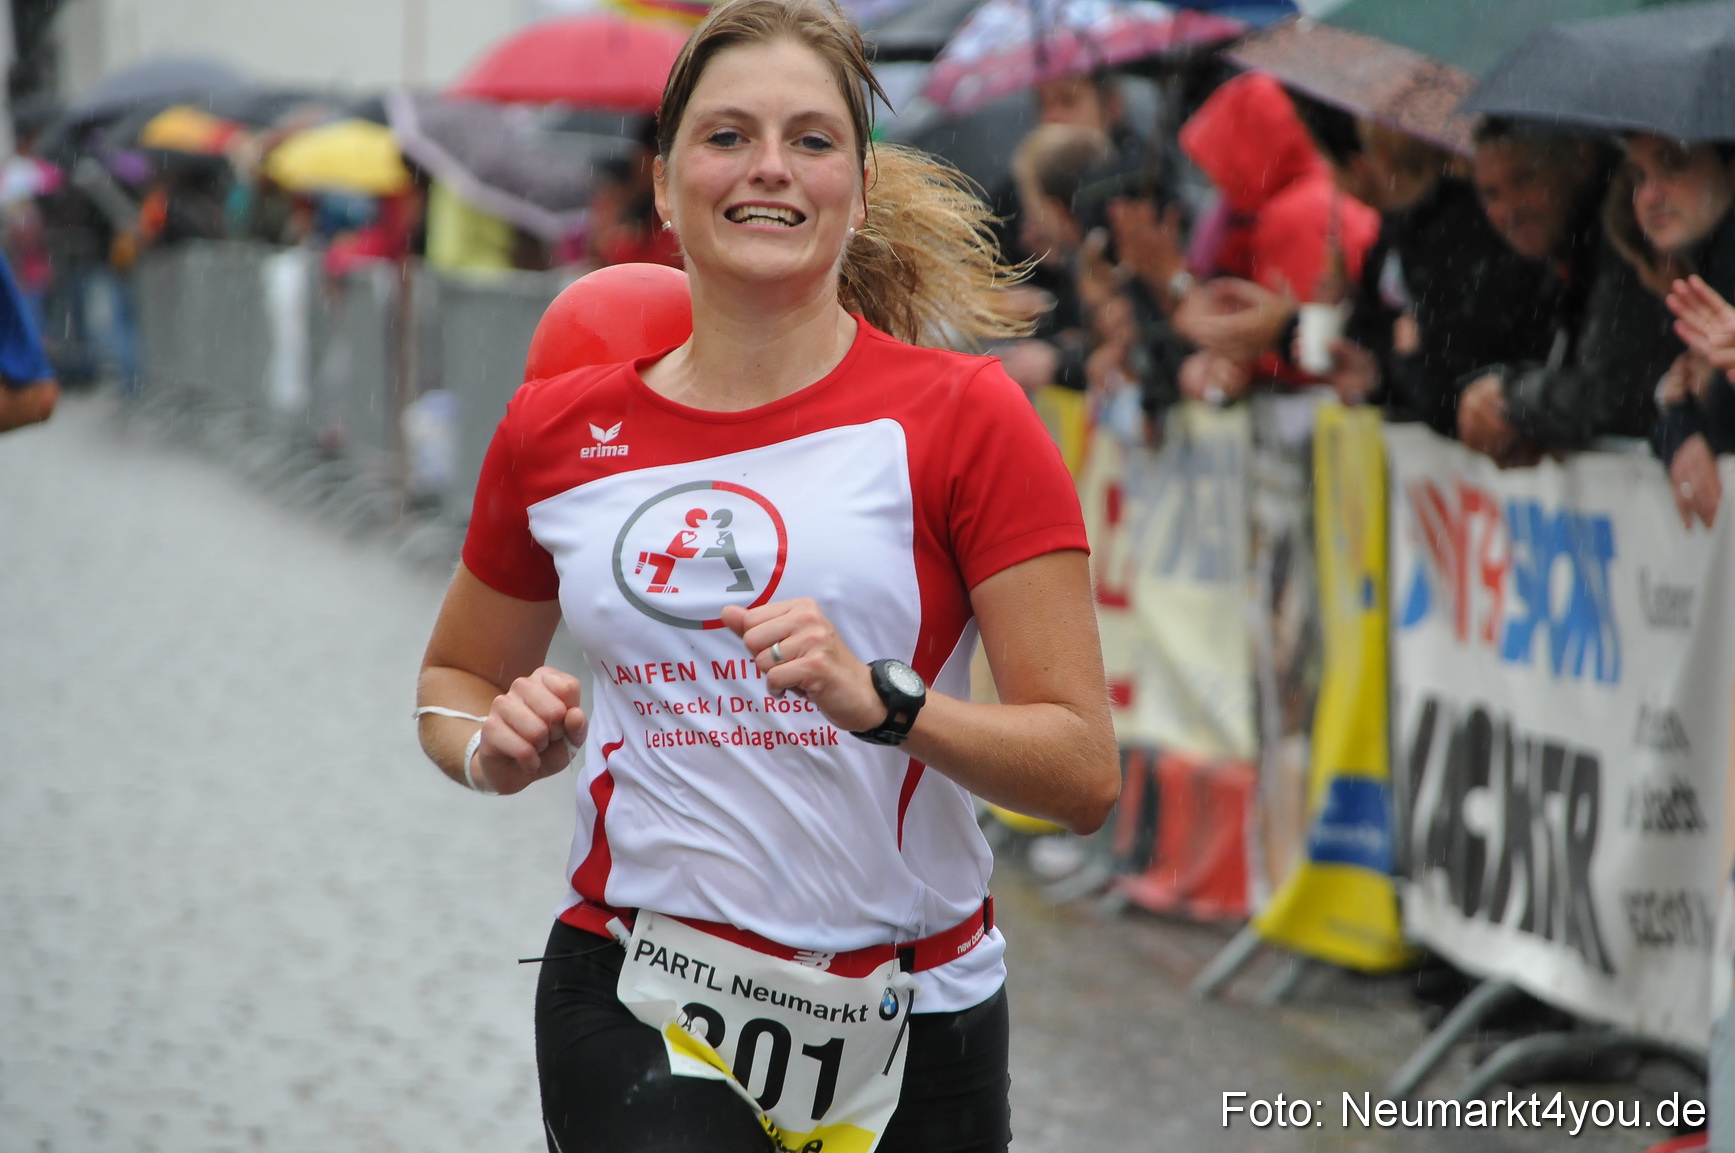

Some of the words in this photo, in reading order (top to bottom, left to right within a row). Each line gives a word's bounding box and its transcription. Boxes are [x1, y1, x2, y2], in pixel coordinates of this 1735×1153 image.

[580, 443, 629, 458] erima
[601, 660, 697, 685] LAUFEN
[711, 659, 762, 680] MIT
[634, 701, 660, 716] Dr.
[730, 697, 759, 713] Dr.
[764, 695, 821, 713] Rösc
[645, 725, 839, 750] Leistungsdiagnostik
[633, 938, 723, 992] PARTL
[731, 974, 869, 1024] Neumarkt
